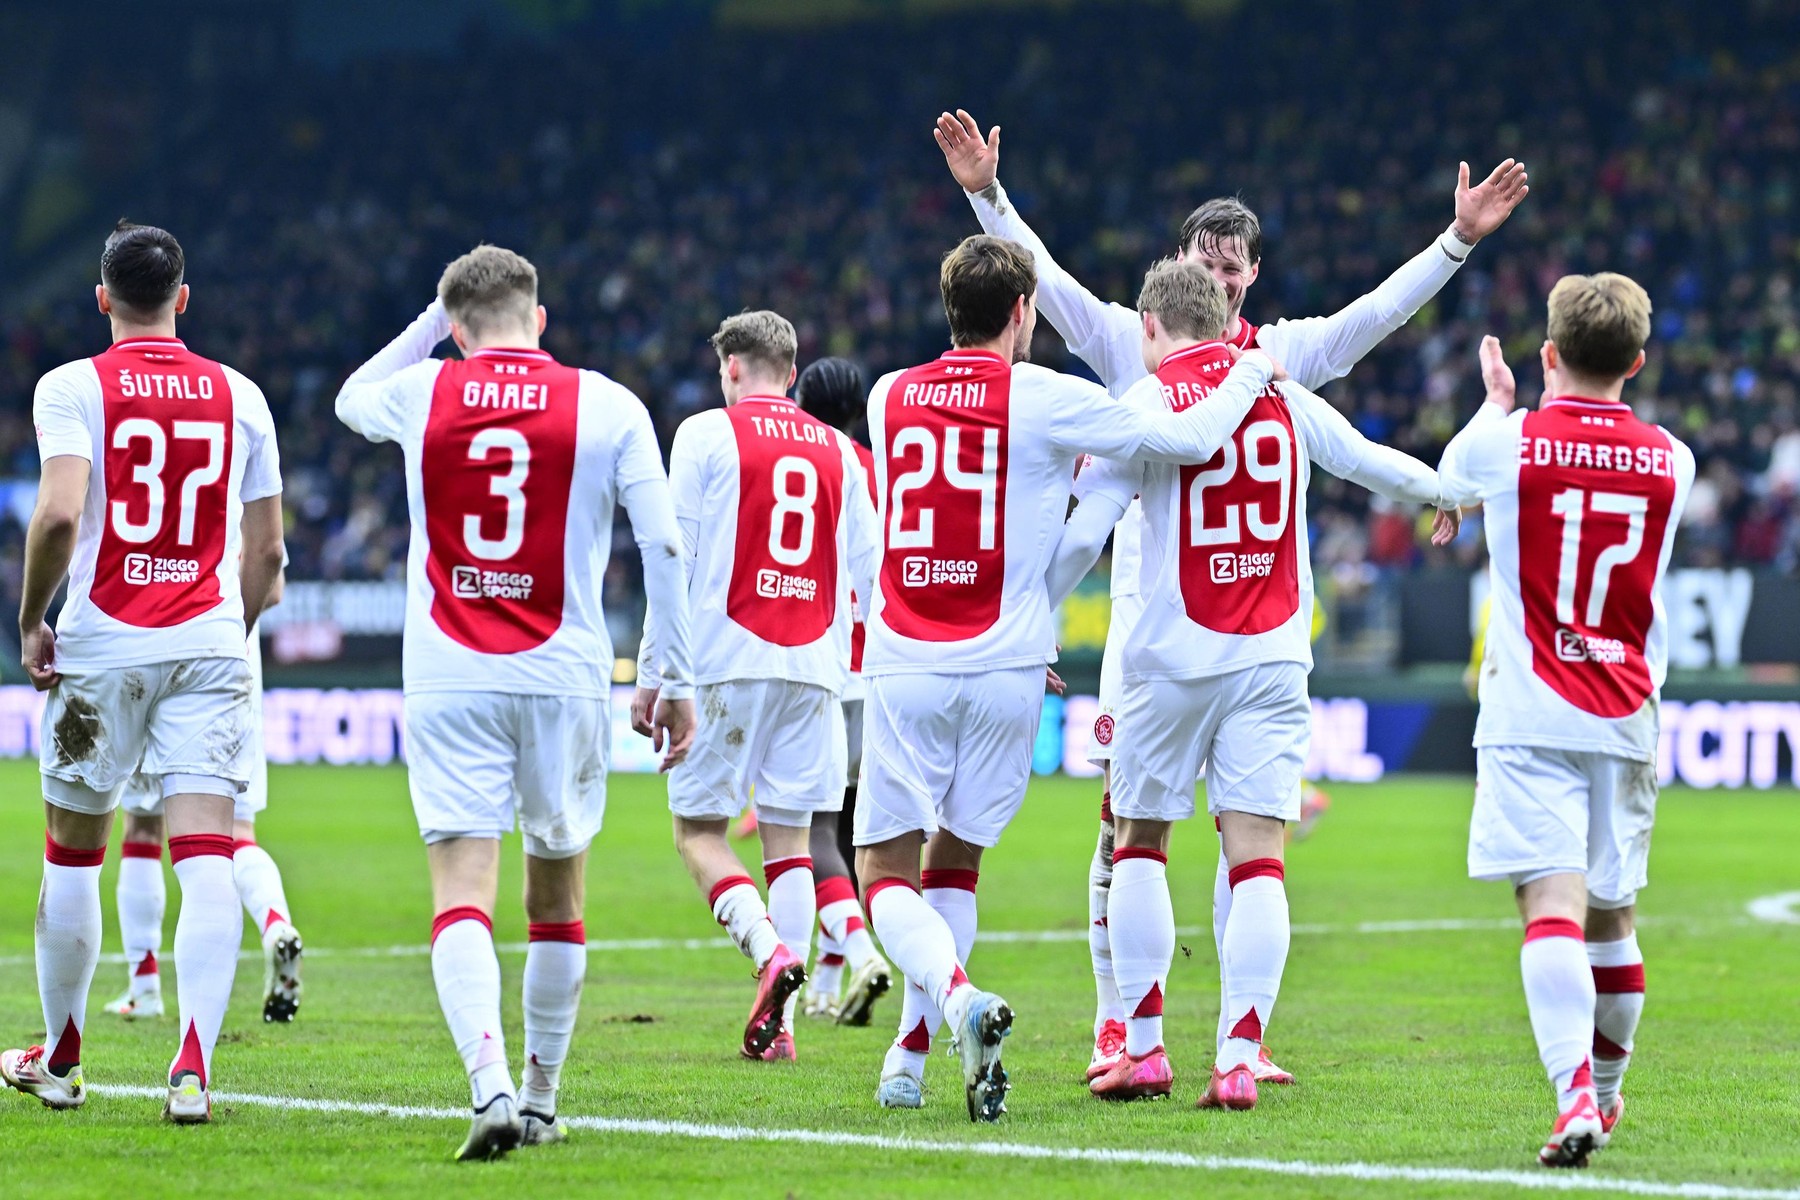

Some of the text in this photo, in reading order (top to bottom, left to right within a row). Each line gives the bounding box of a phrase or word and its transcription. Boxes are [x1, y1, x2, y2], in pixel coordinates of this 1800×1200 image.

[119, 369, 213, 400] ŠUTALO
[463, 381, 548, 410] GAAEI
[903, 383, 987, 407] RUGANI
[751, 416, 829, 447] TAYLOR
[112, 418, 225, 546] 37
[463, 427, 531, 560] 3
[888, 426, 999, 550] 24
[1190, 420, 1291, 547] 29
[769, 456, 818, 567] 8
[153, 557, 200, 572] ZIGGO
[932, 560, 978, 572] ZIGGO
[1551, 487, 1649, 628] 17
[153, 571, 199, 583] SPORT
[482, 571, 534, 587] ZIGGO
[781, 574, 817, 590] ZIGGO
[931, 572, 977, 585] SPORT
[482, 585, 532, 600] SPORT
[781, 587, 816, 602] SPORT
